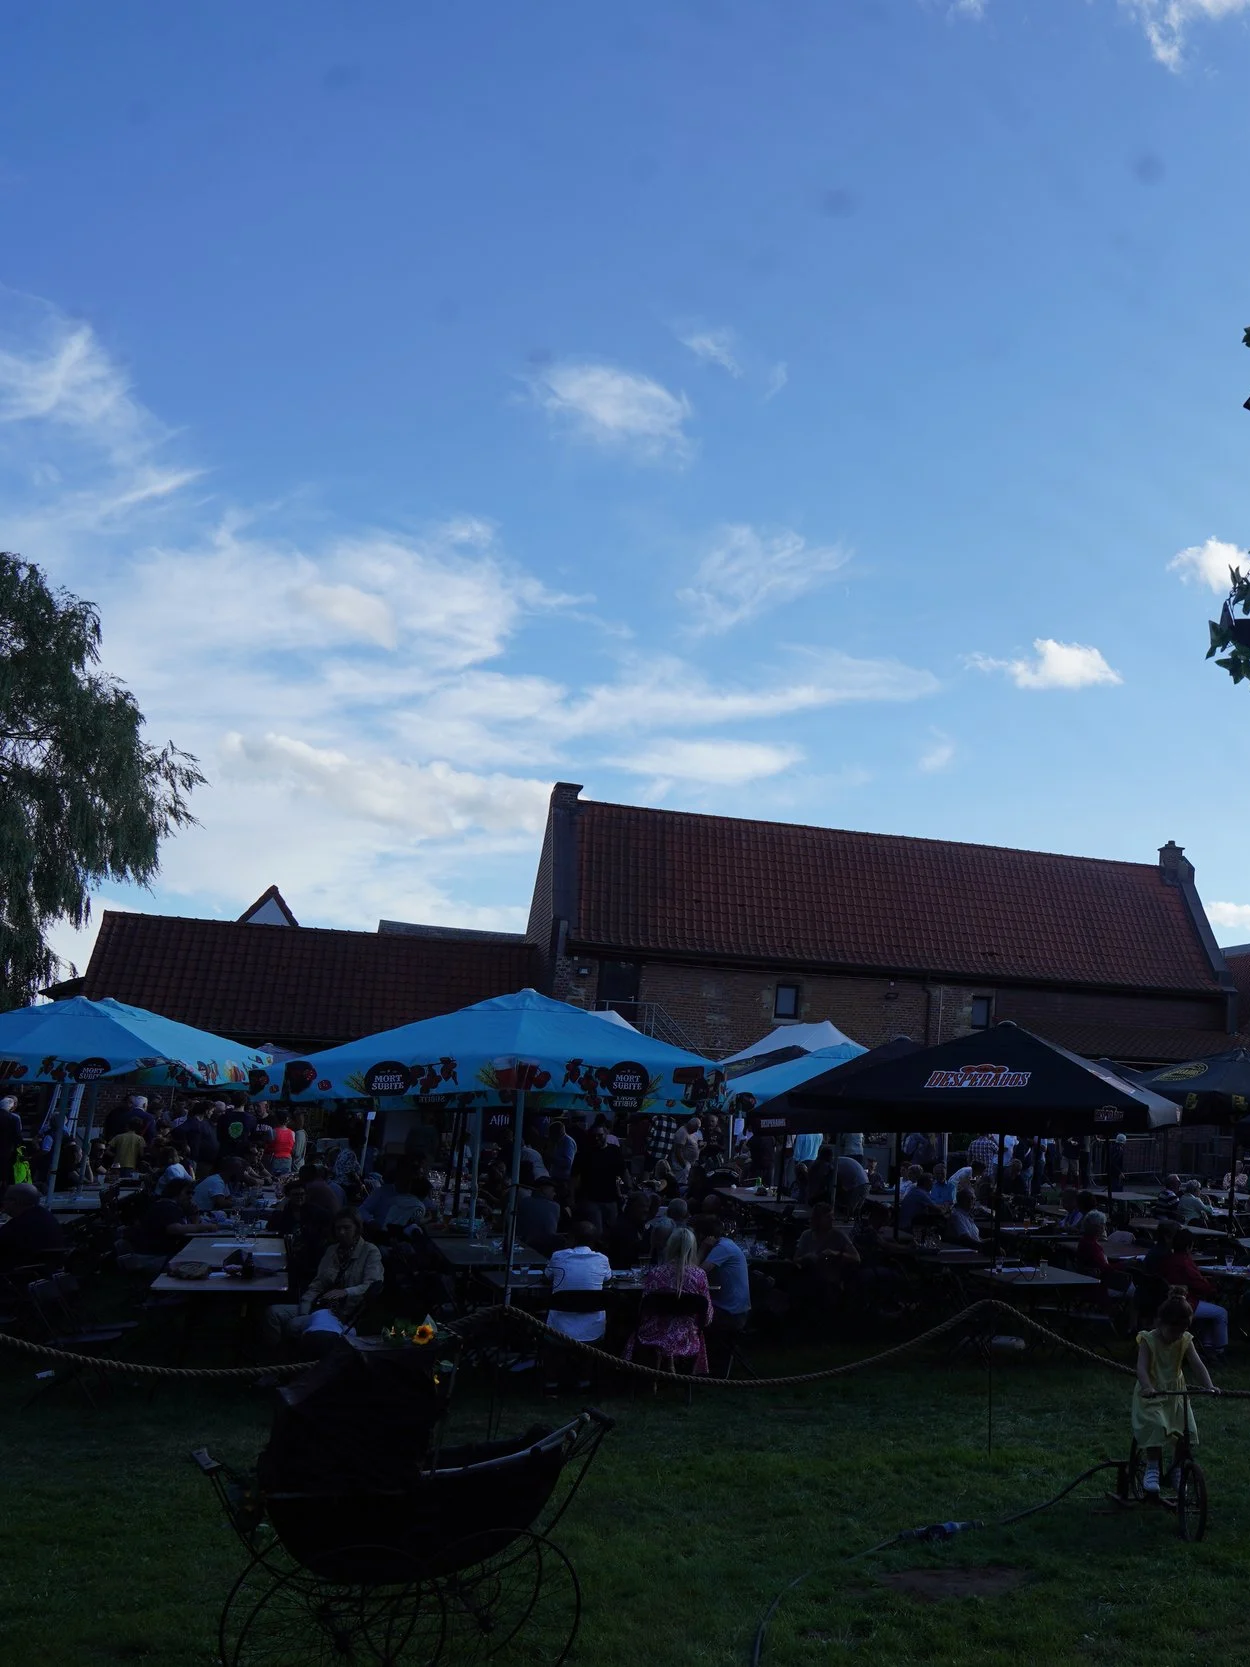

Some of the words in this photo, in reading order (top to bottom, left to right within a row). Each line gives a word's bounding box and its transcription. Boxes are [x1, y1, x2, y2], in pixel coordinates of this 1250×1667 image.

[374, 1074, 403, 1082] MORT
[615, 1074, 641, 1082] MORT
[924, 1070, 1032, 1088] DESPERADOS
[371, 1082, 405, 1090] SUBITE
[612, 1082, 643, 1090] SUBITE
